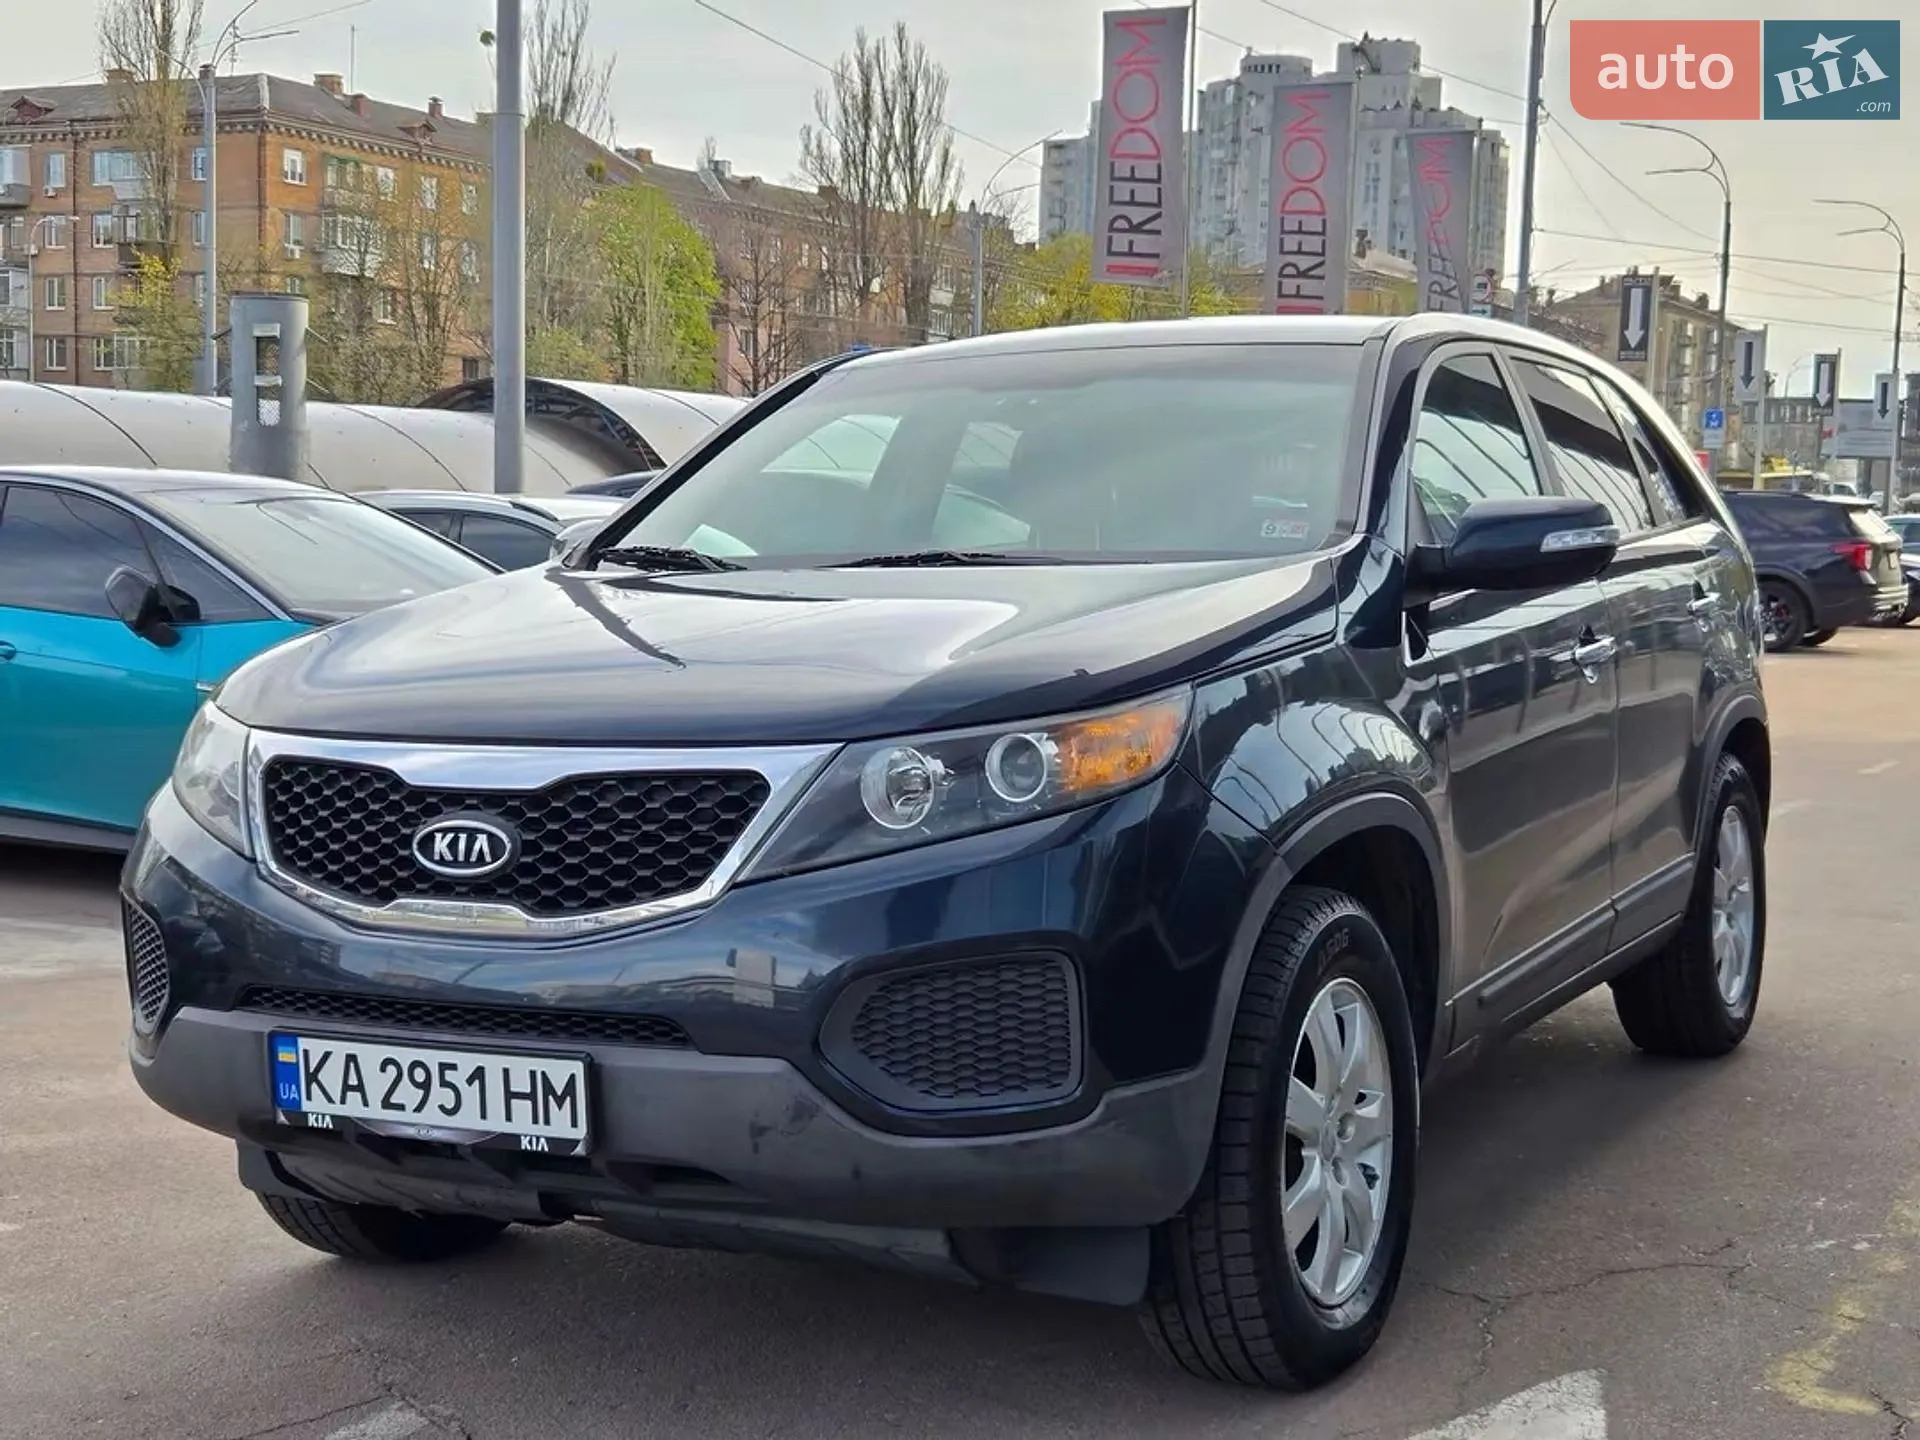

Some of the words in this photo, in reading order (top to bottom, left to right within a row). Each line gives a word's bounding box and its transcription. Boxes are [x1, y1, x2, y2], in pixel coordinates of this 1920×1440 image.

[1106, 17, 1168, 259] FREEDOM
[1277, 90, 1332, 301] FREEDOM
[433, 831, 492, 863] KIA
[279, 1081, 300, 1101] UA
[302, 1048, 370, 1109] KA
[379, 1056, 487, 1120] 2951
[502, 1066, 578, 1129] HM
[307, 1112, 334, 1130] KIA
[520, 1135, 549, 1152] KIA
